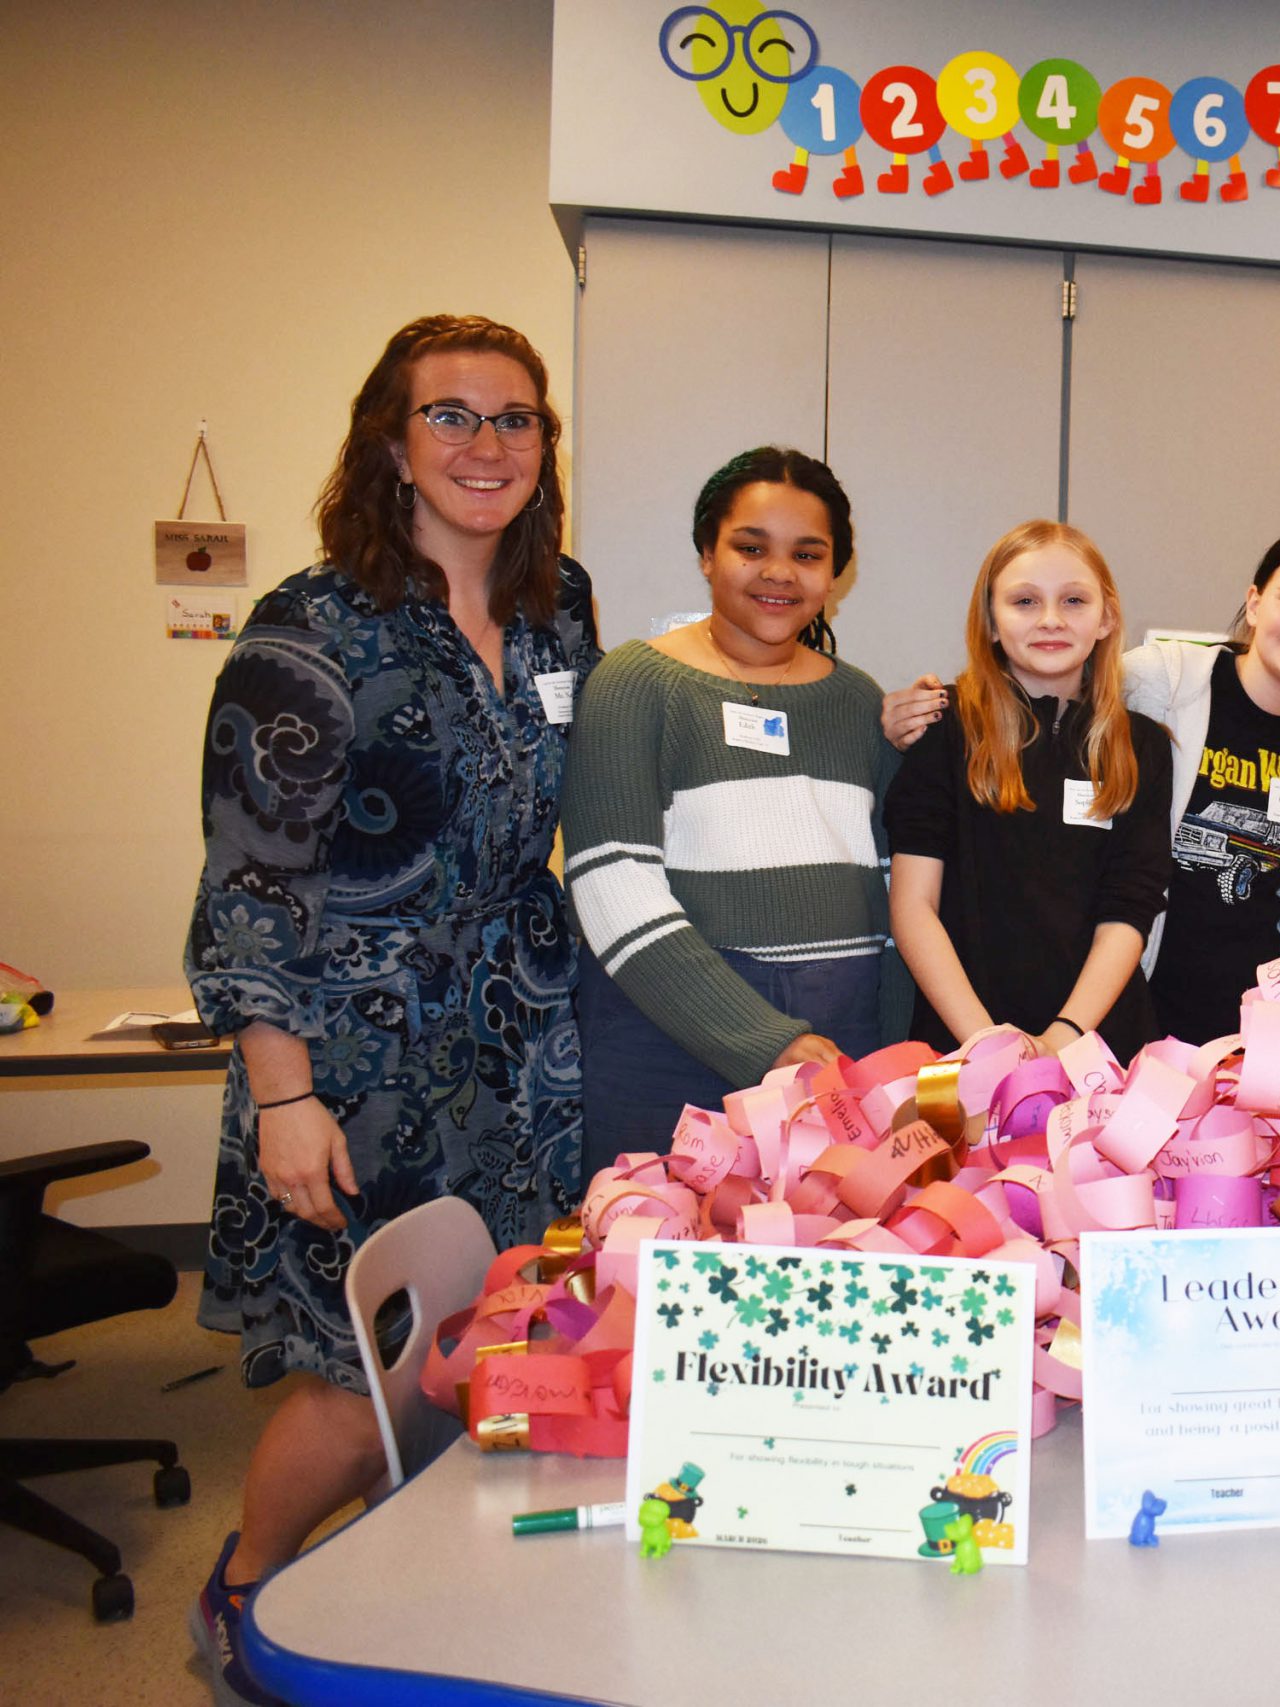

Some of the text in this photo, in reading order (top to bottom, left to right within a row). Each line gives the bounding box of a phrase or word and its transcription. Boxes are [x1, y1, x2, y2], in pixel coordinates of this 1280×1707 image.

[811, 83, 837, 142] 1
[882, 82, 924, 139] 2
[964, 67, 998, 125] 3
[1035, 75, 1077, 129] 4
[1123, 96, 1161, 148] 5
[1193, 94, 1225, 147] 6
[165, 533, 229, 543] MISS SARAH
[182, 609, 212, 619] Sarah
[1199, 746, 1256, 789] rgan
[676, 1350, 993, 1401] Flexibility Award
[1141, 1400, 1162, 1416] For
[1168, 1397, 1228, 1416] showing
[1233, 1396, 1273, 1413] great
[1144, 1422, 1175, 1438] and
[1178, 1421, 1221, 1439] being
[1230, 1423, 1240, 1433] a
[730, 1452, 915, 1471] For showing flexibility in tough situations
[1210, 1487, 1244, 1500] Teacher
